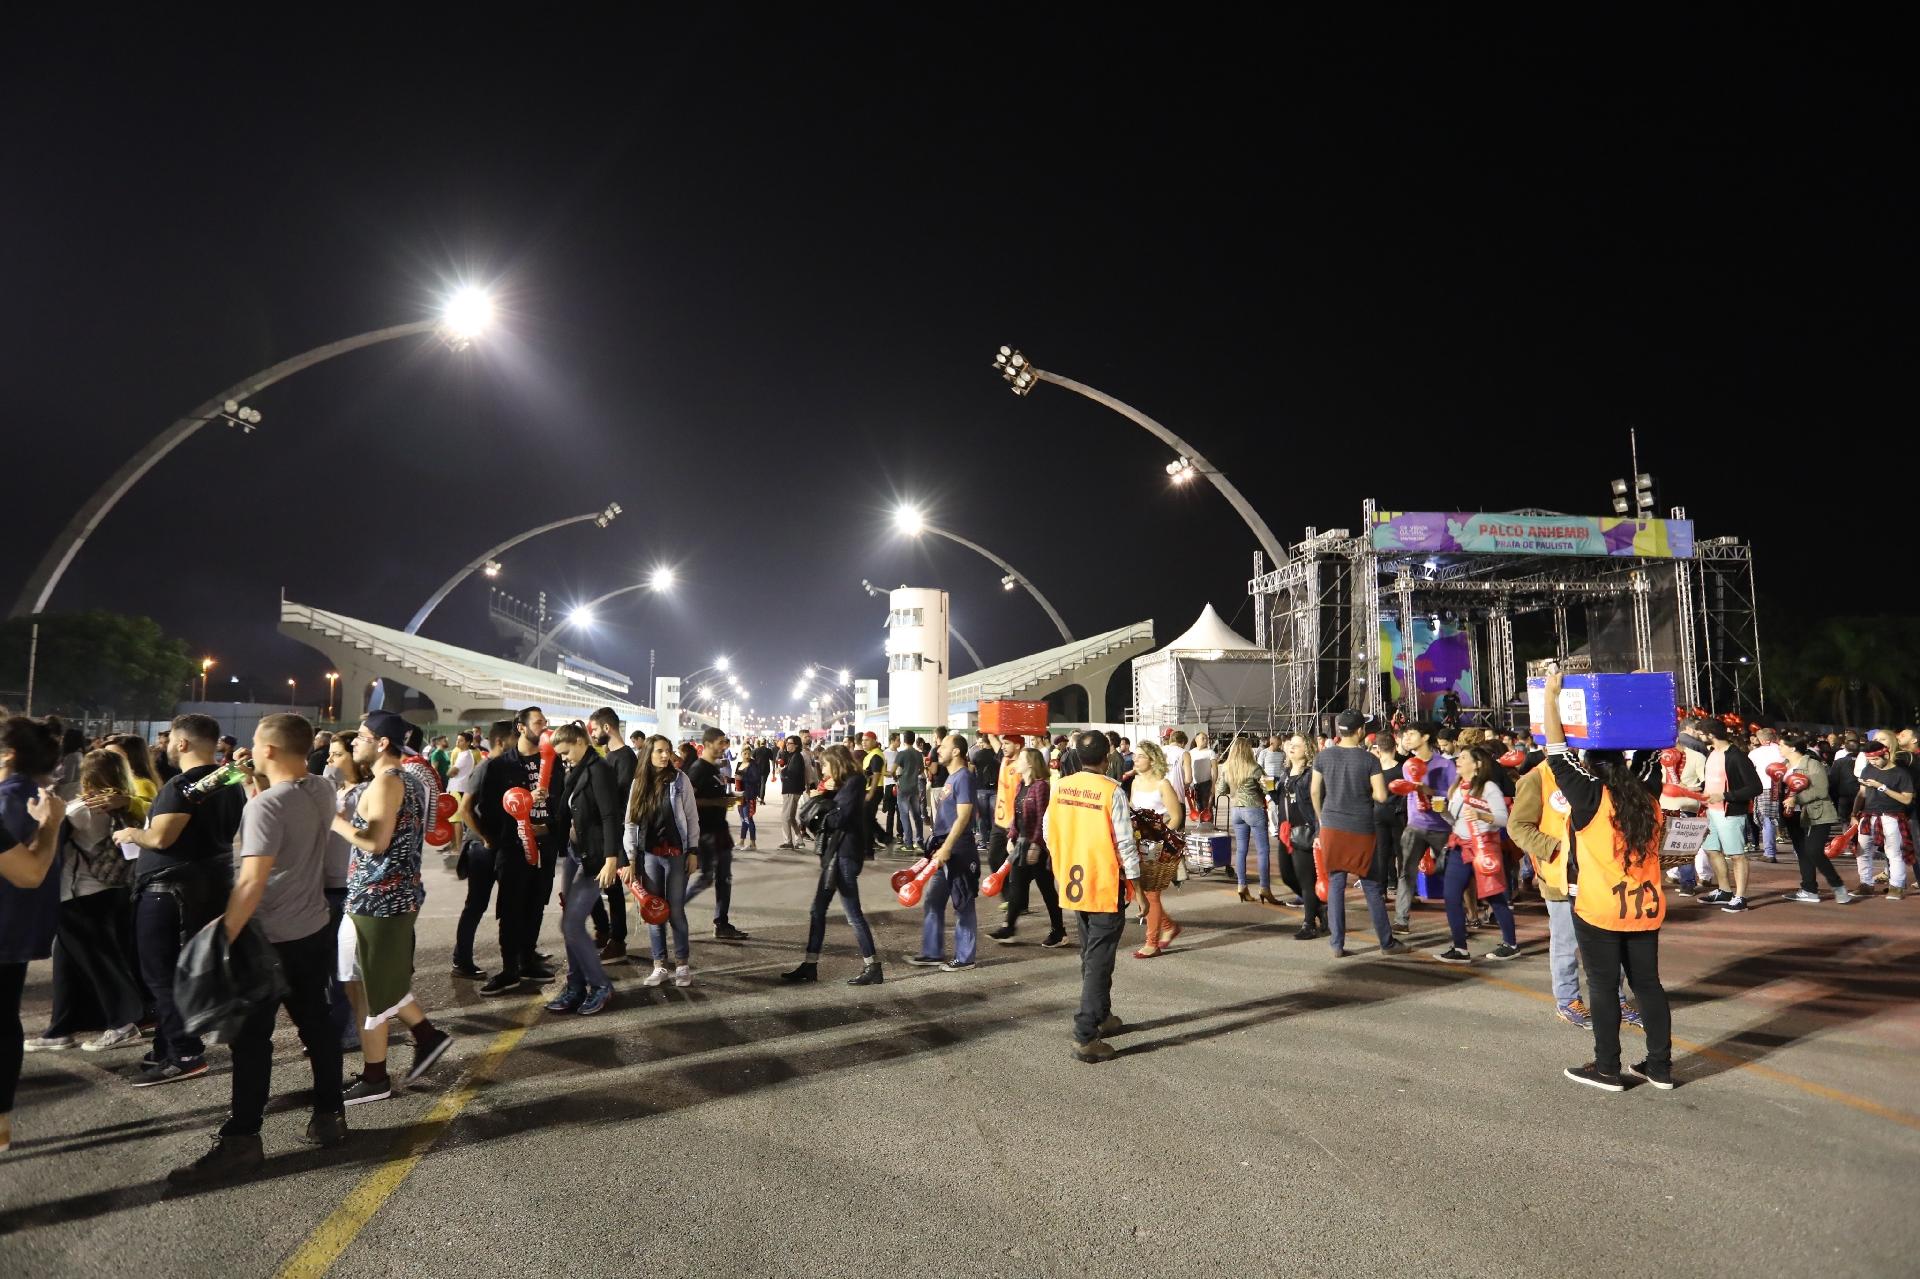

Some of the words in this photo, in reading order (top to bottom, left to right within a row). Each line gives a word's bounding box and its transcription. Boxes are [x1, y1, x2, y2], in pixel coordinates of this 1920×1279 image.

[1479, 523, 1524, 537] PALCO
[1528, 526, 1589, 539] ANHEMBI
[1522, 541, 1534, 549] DE
[1536, 541, 1574, 549] PAULISTA
[1670, 841, 1681, 849] R$
[1066, 864, 1084, 903] 8
